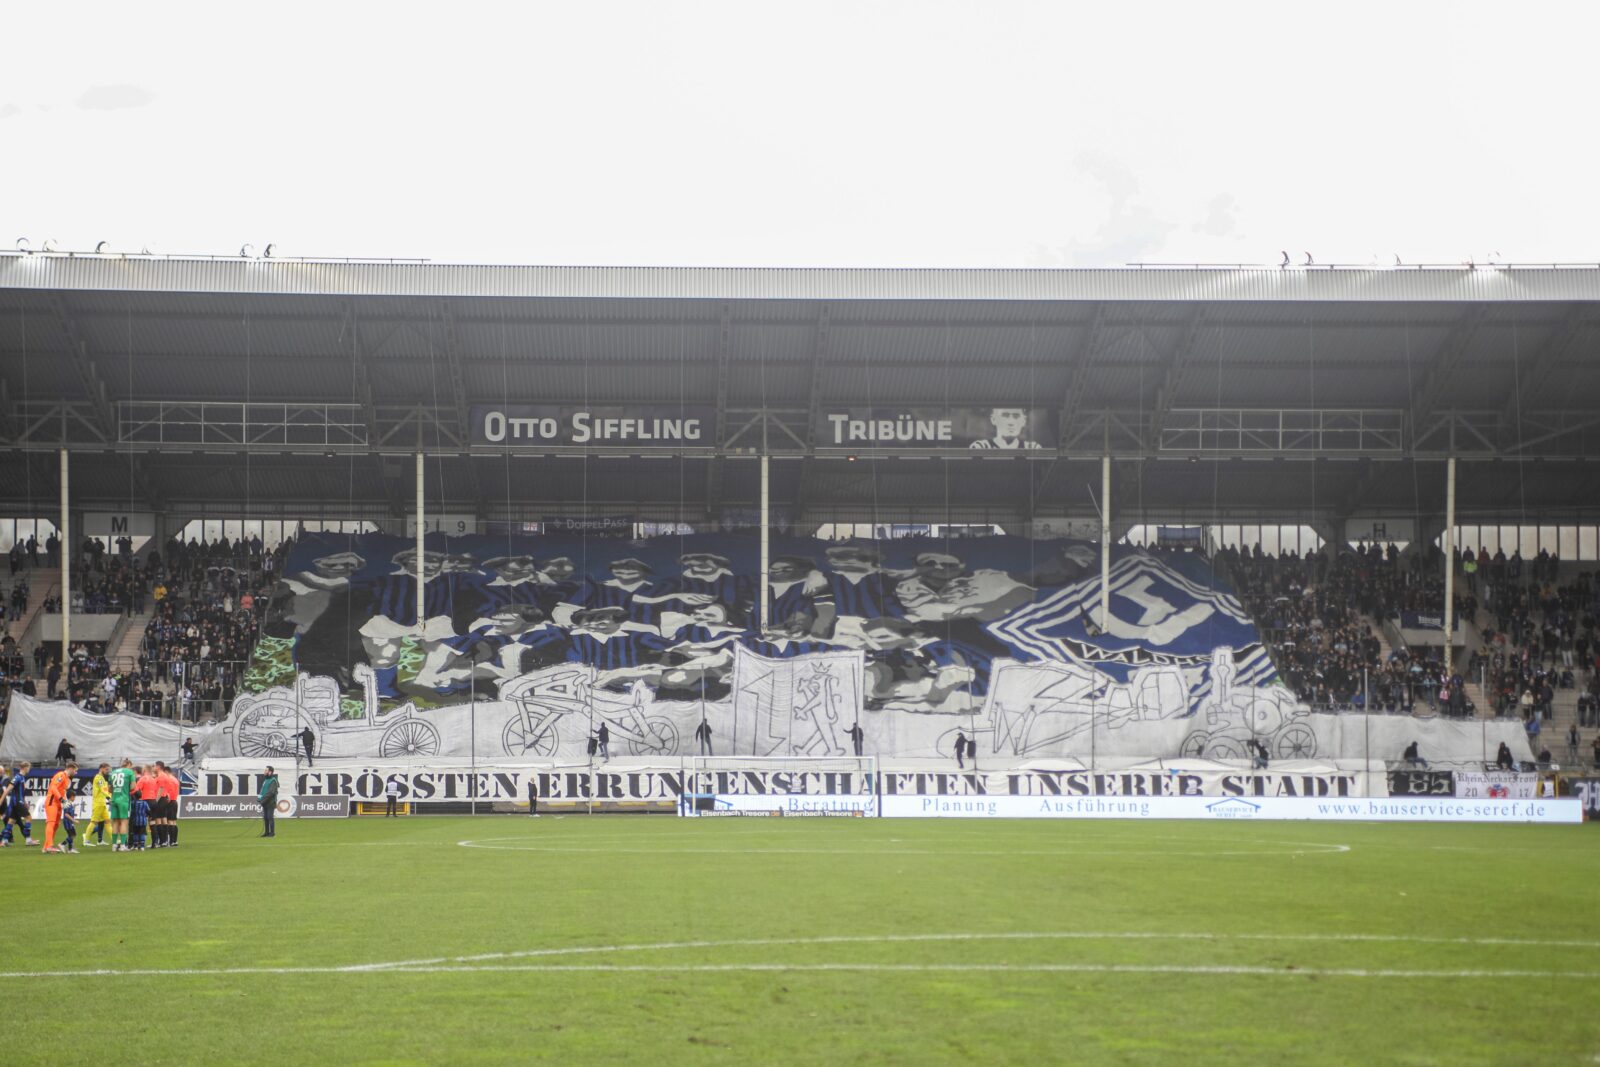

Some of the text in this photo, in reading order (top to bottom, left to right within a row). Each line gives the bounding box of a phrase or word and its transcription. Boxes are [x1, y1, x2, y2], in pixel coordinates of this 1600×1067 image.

[111, 516, 128, 533] M
[457, 520, 466, 533] 9
[1373, 522, 1386, 539] H
[25, 778, 51, 790] CLU
[112, 772, 125, 788] 26
[297, 768, 520, 799] GRÖSSTEN
[1221, 775, 1356, 797] STADT
[195, 801, 236, 813] Dallmayr
[301, 802, 314, 811] ins
[317, 801, 342, 811] Büro!
[788, 797, 873, 816] Beratung
[922, 797, 997, 815] Planung
[1039, 798, 1150, 816] Ausführung
[1318, 802, 1546, 817] www.bauservice-seref.de
